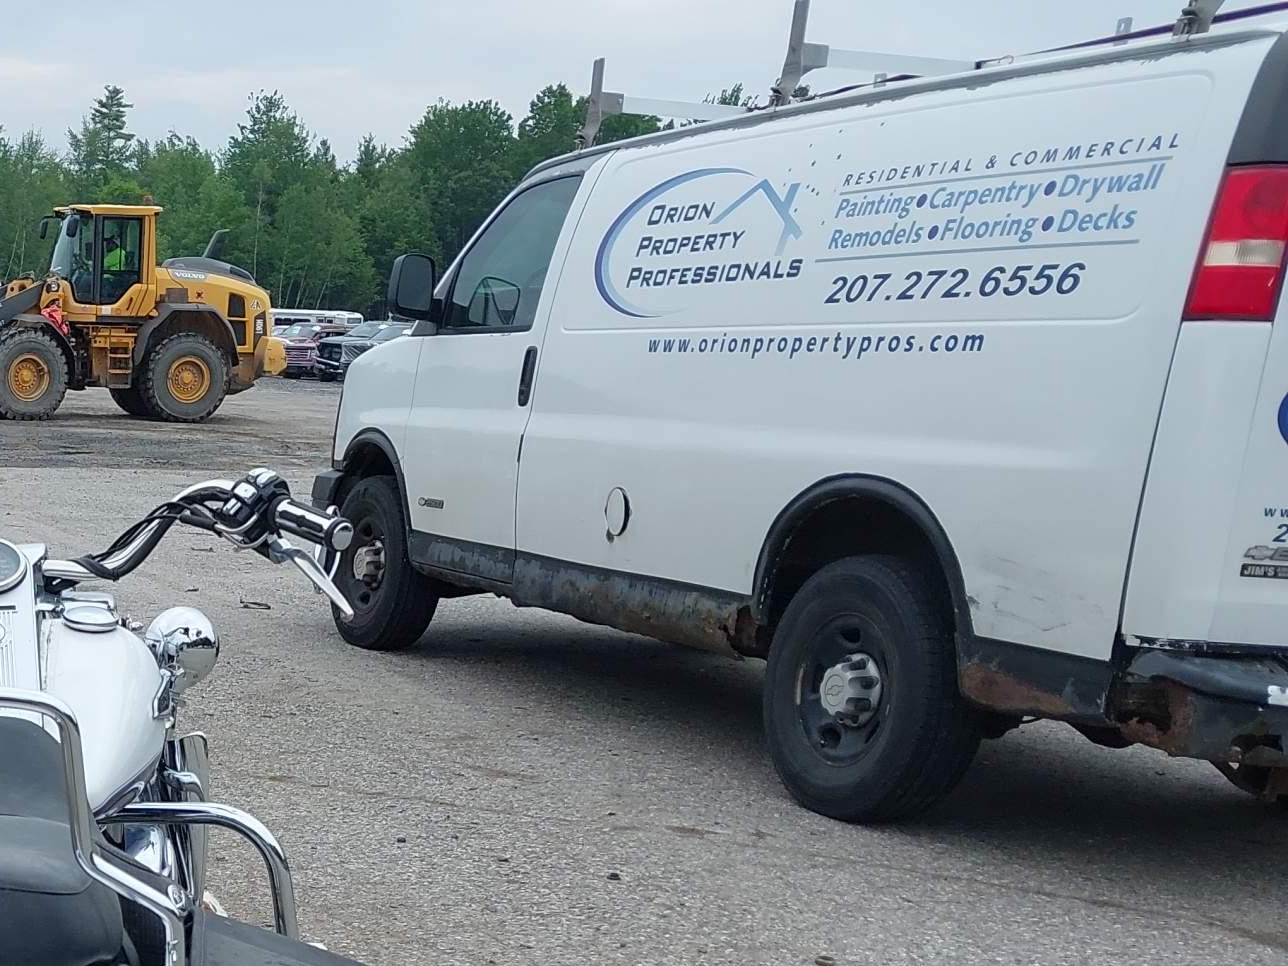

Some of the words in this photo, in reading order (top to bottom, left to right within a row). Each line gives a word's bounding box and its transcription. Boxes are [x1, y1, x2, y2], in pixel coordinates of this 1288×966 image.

[842, 158, 973, 187] RESIDENTIAL
[985, 154, 998, 170] &
[1009, 133, 1180, 167] COMMERCIAL
[834, 192, 917, 220] Painting
[928, 180, 1043, 214] Carpentry
[1057, 163, 1166, 203] Drywall
[647, 201, 716, 226] ORION
[828, 220, 925, 250] Remodels
[939, 213, 1039, 243] Flooring
[1056, 204, 1138, 233] Decks
[635, 230, 746, 258] PROPERTY
[174, 271, 206, 279] VOLVO
[626, 258, 804, 289] PROFESSIONALS
[823, 262, 1086, 304] 207.272.6556
[647, 331, 986, 360] www.orionpropertypros.com
[1243, 565, 1275, 576] JIM'S
